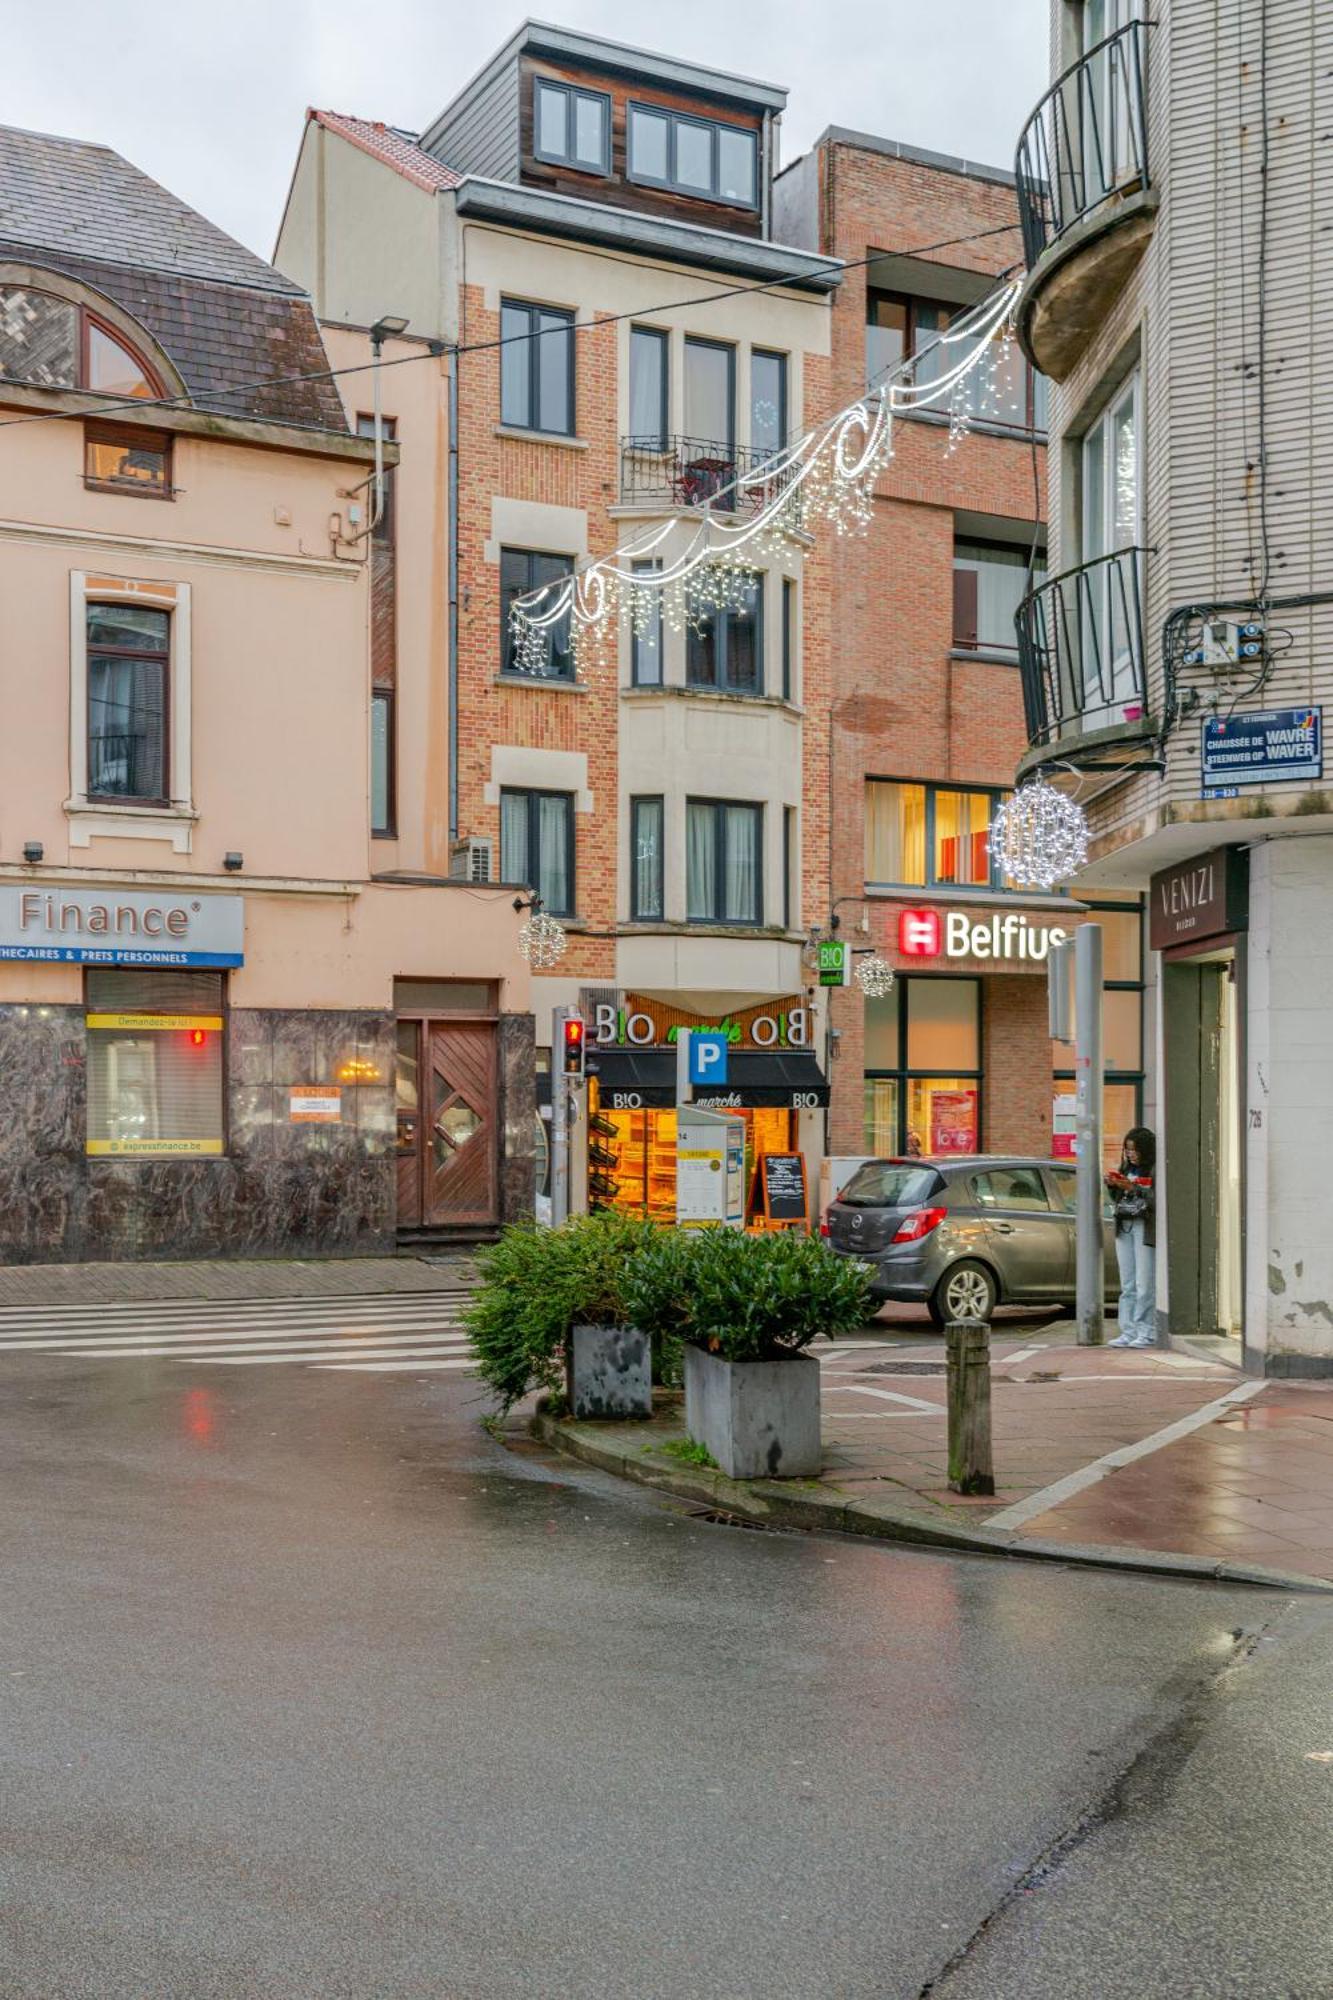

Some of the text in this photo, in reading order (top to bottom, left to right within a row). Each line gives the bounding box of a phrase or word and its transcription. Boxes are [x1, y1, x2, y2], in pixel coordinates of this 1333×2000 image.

[1207, 727, 1314, 750] CHAUSSÉE DE WAVRE
[1207, 742, 1314, 765] STEENWEG OP WAVER
[1161, 864, 1213, 917] VENIZI
[65, 950, 75, 960] &
[81, 950, 114, 962] PRETS
[116, 951, 189, 964] PERSONNELS
[698, 1043, 721, 1073] P
[697, 1092, 742, 1108] marché
